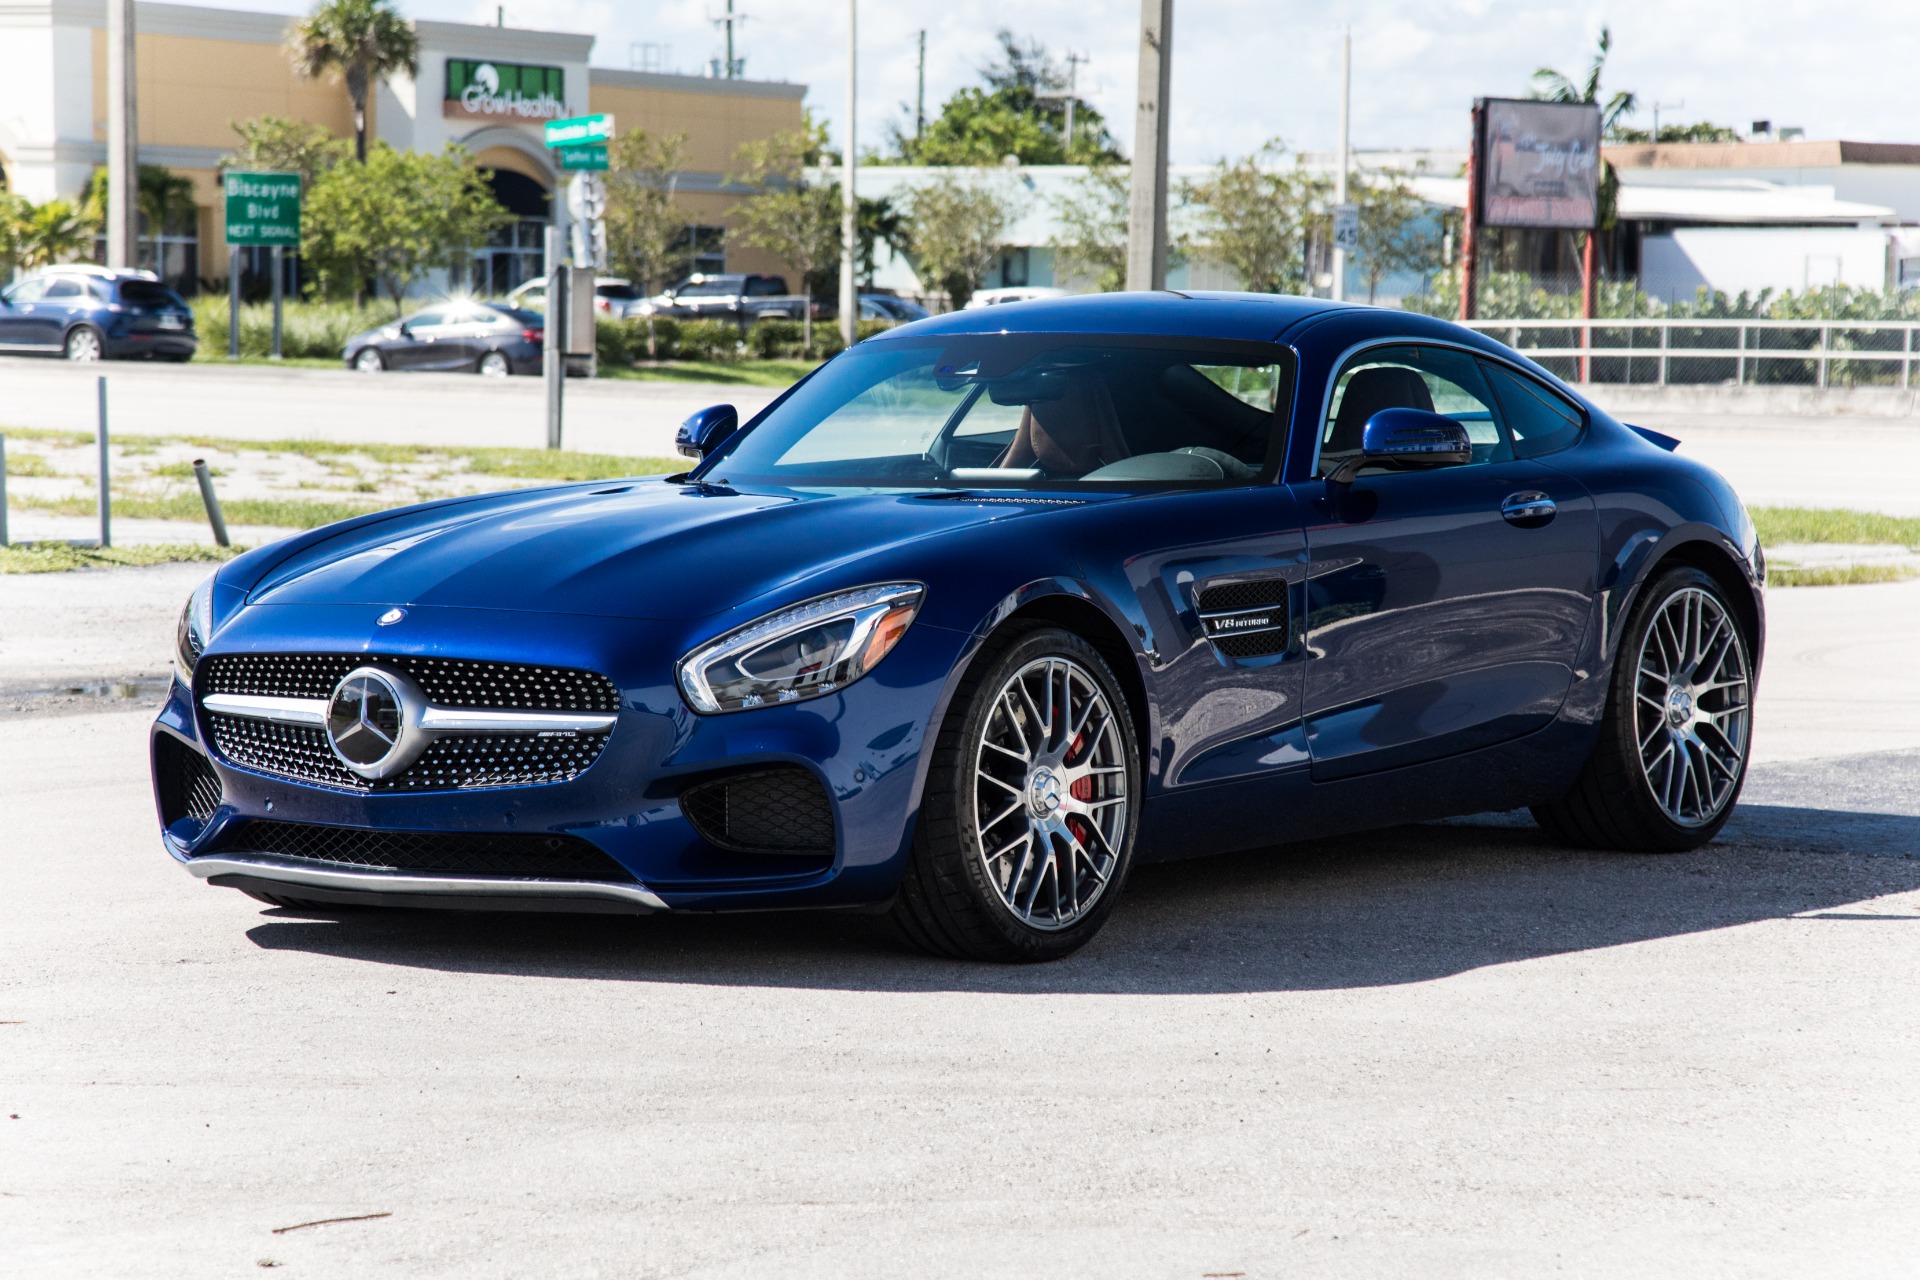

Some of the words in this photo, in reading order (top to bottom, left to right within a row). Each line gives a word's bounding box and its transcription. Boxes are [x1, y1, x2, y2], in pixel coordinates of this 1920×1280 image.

[227, 178, 299, 200] Biscayne
[247, 202, 279, 219] Blvd
[1337, 229, 1358, 246] 45
[1215, 619, 1235, 630] V8
[1235, 617, 1269, 628] BITURBO
